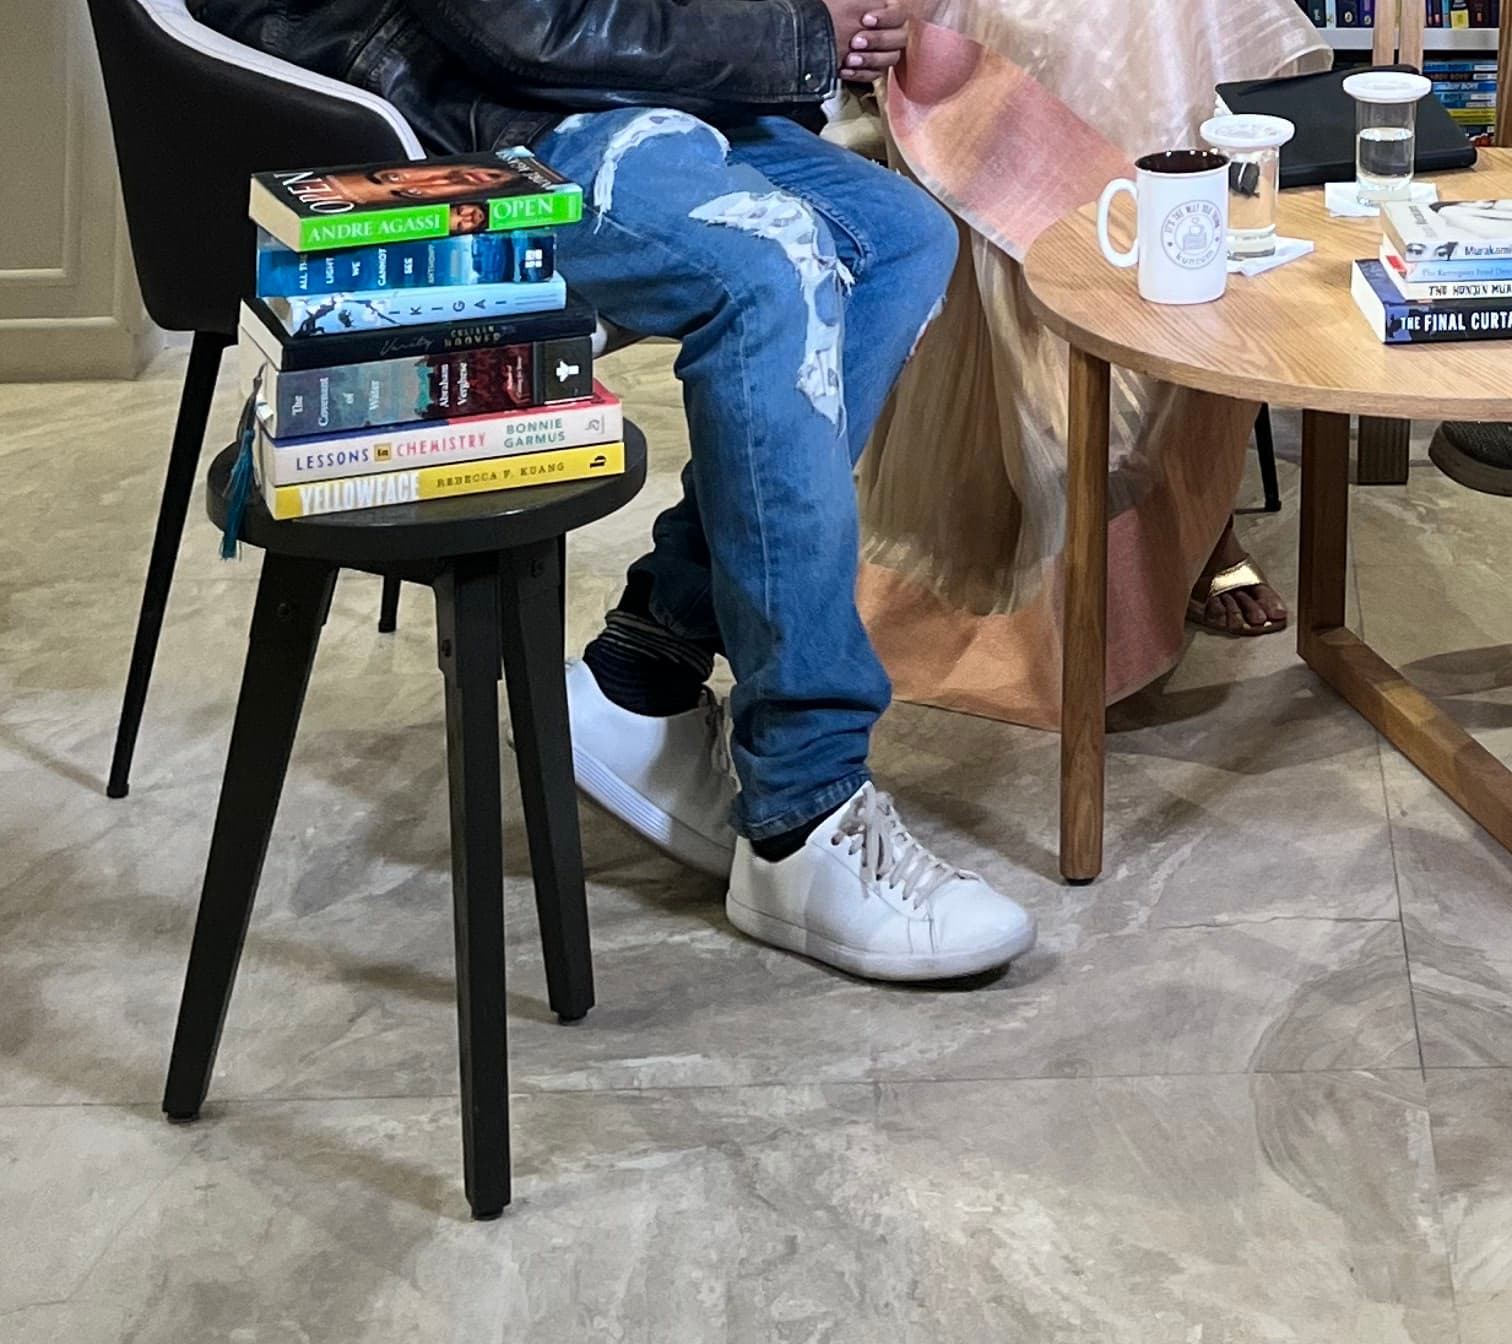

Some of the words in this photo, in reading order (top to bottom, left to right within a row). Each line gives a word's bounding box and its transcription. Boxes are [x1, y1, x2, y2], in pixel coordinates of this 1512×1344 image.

[273, 171, 356, 215] OPEN
[493, 198, 554, 219] OPEN
[308, 220, 374, 243] ANDRE
[380, 214, 441, 233] AGASSI
[1464, 243, 1512, 256] Murakami
[325, 257, 334, 284] LIGHT
[351, 261, 361, 276] WE
[376, 248, 386, 287] CANNOT
[404, 258, 413, 274] SEE
[299, 271, 308, 289] ALL
[1429, 285, 1448, 296] THE
[1400, 315, 1421, 331] THE
[1424, 314, 1466, 332] FINAL
[438, 362, 450, 408] Abraham
[457, 361, 468, 406] Verghese
[292, 395, 302, 416] The
[318, 377, 329, 428] Covenant
[346, 390, 355, 405] of
[506, 418, 563, 436] BONNIE
[504, 431, 566, 449] GARMUS
[296, 448, 369, 471] LESSONS
[397, 432, 486, 458] CHEMISTRY
[437, 472, 498, 489] REBECCA
[520, 461, 566, 477] KUANG
